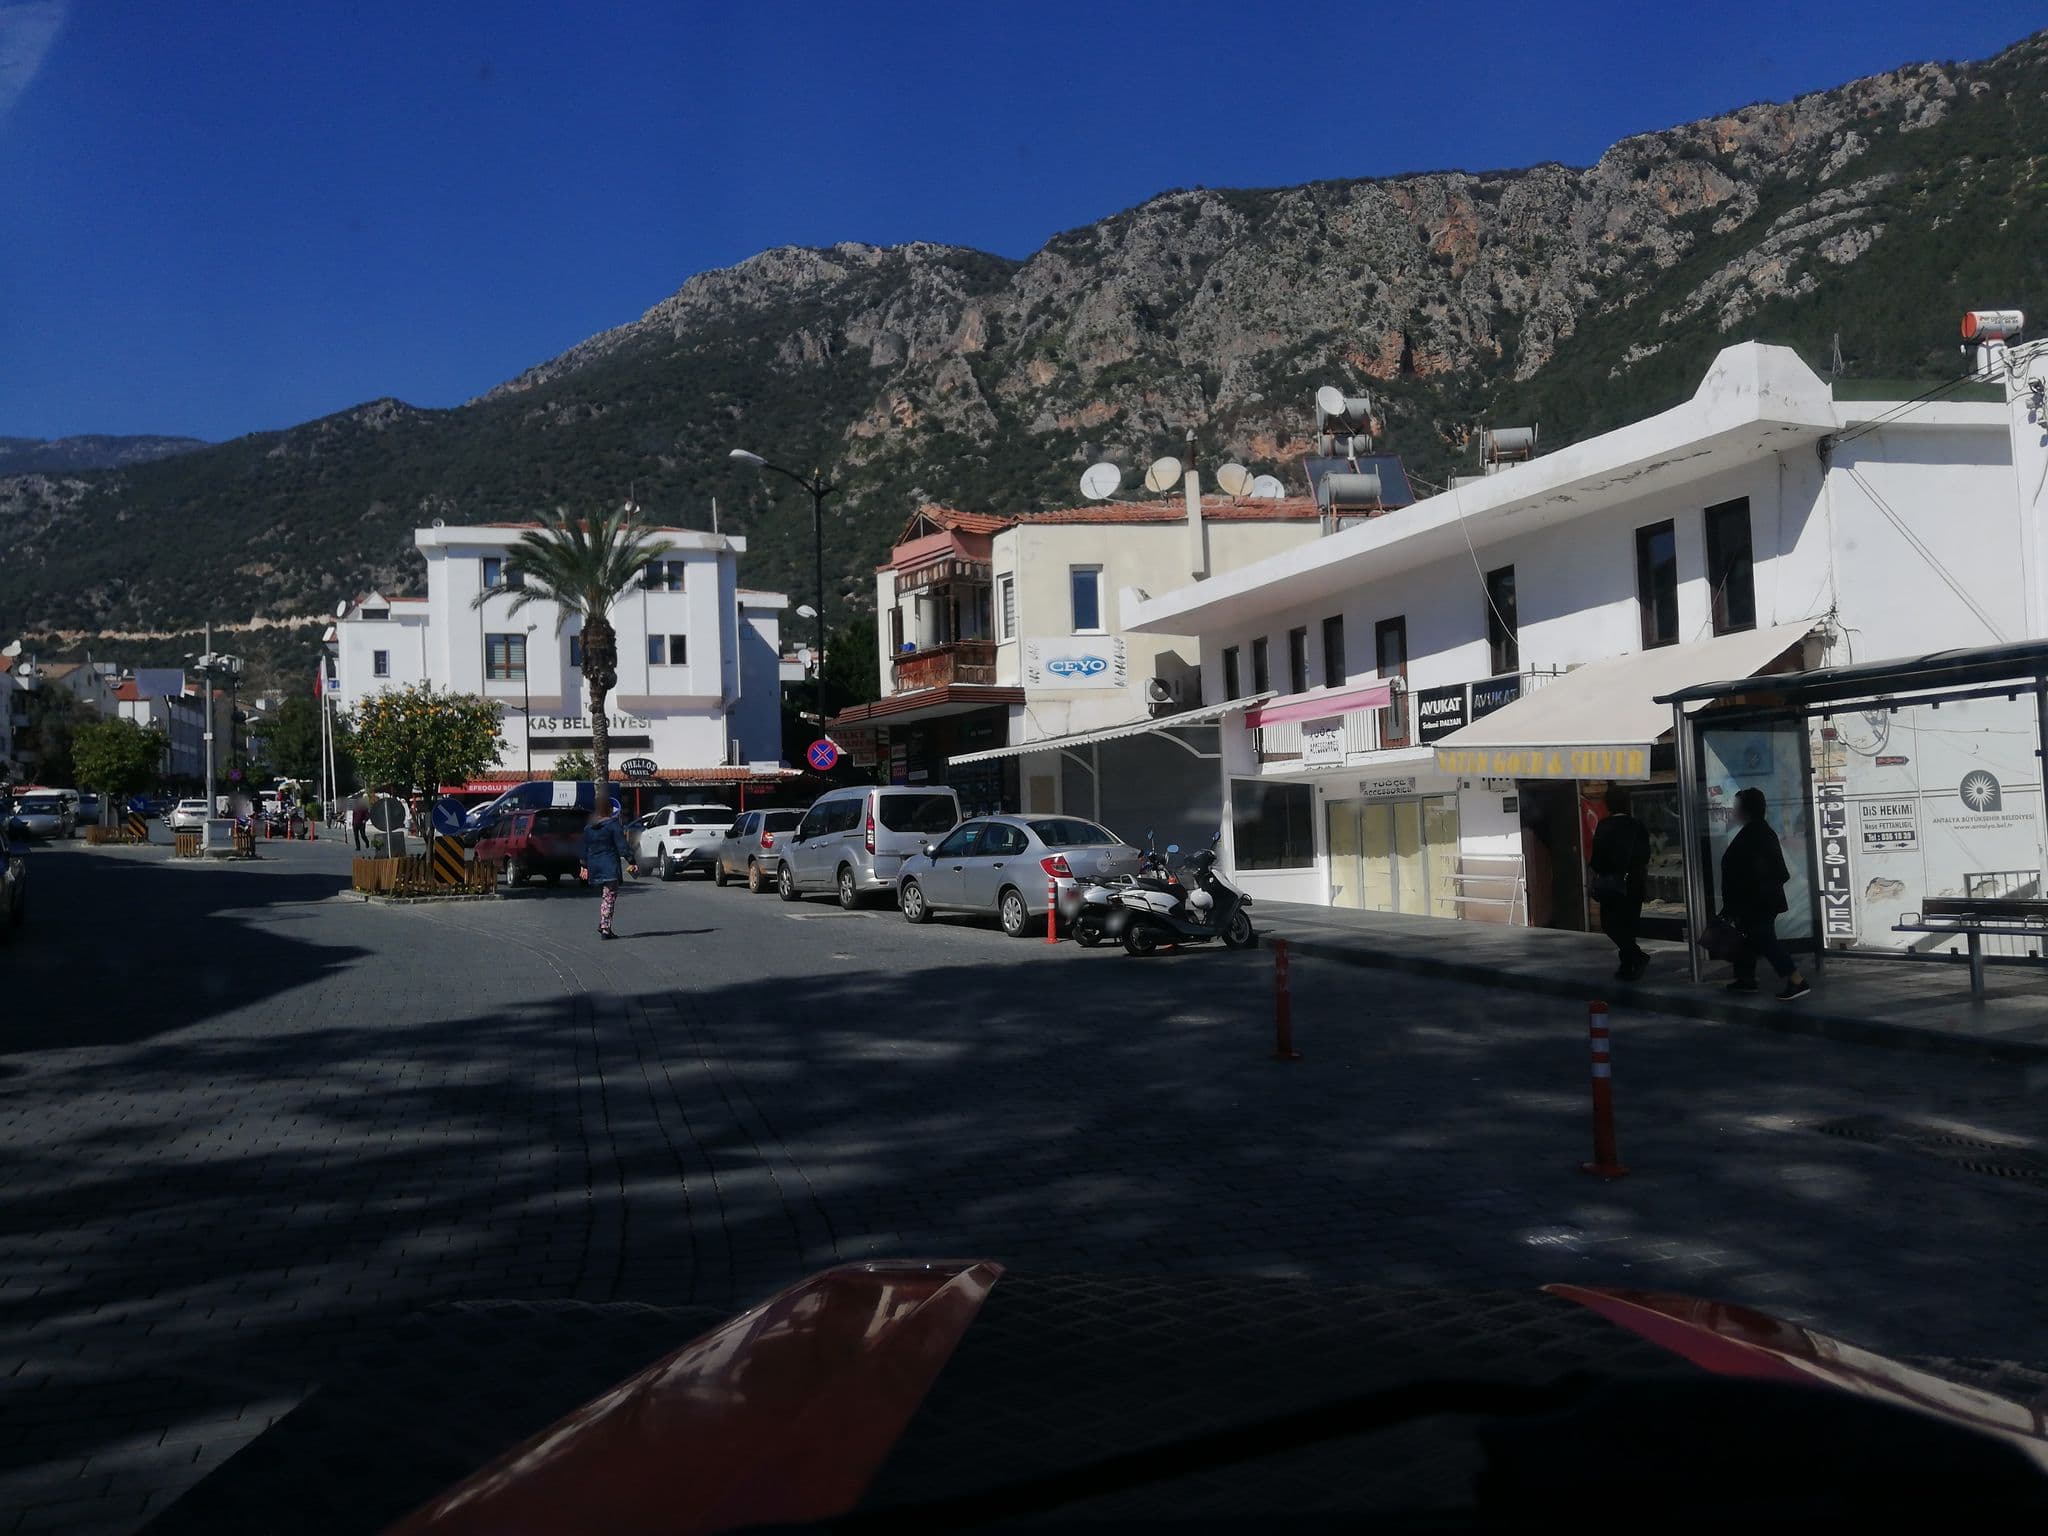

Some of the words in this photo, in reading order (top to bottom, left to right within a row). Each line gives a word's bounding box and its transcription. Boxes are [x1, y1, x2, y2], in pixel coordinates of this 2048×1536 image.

[1049, 660, 1105, 672] CEYO
[1420, 697, 1462, 716] AVUKAT
[1473, 688, 1518, 708] AVUKAT
[528, 717, 557, 733] KAŞ
[622, 759, 657, 771] PHELLOS
[1493, 751, 1544, 775] GOLD
[1572, 751, 1644, 775] SILVER
[1824, 853, 1853, 932] SILVER
